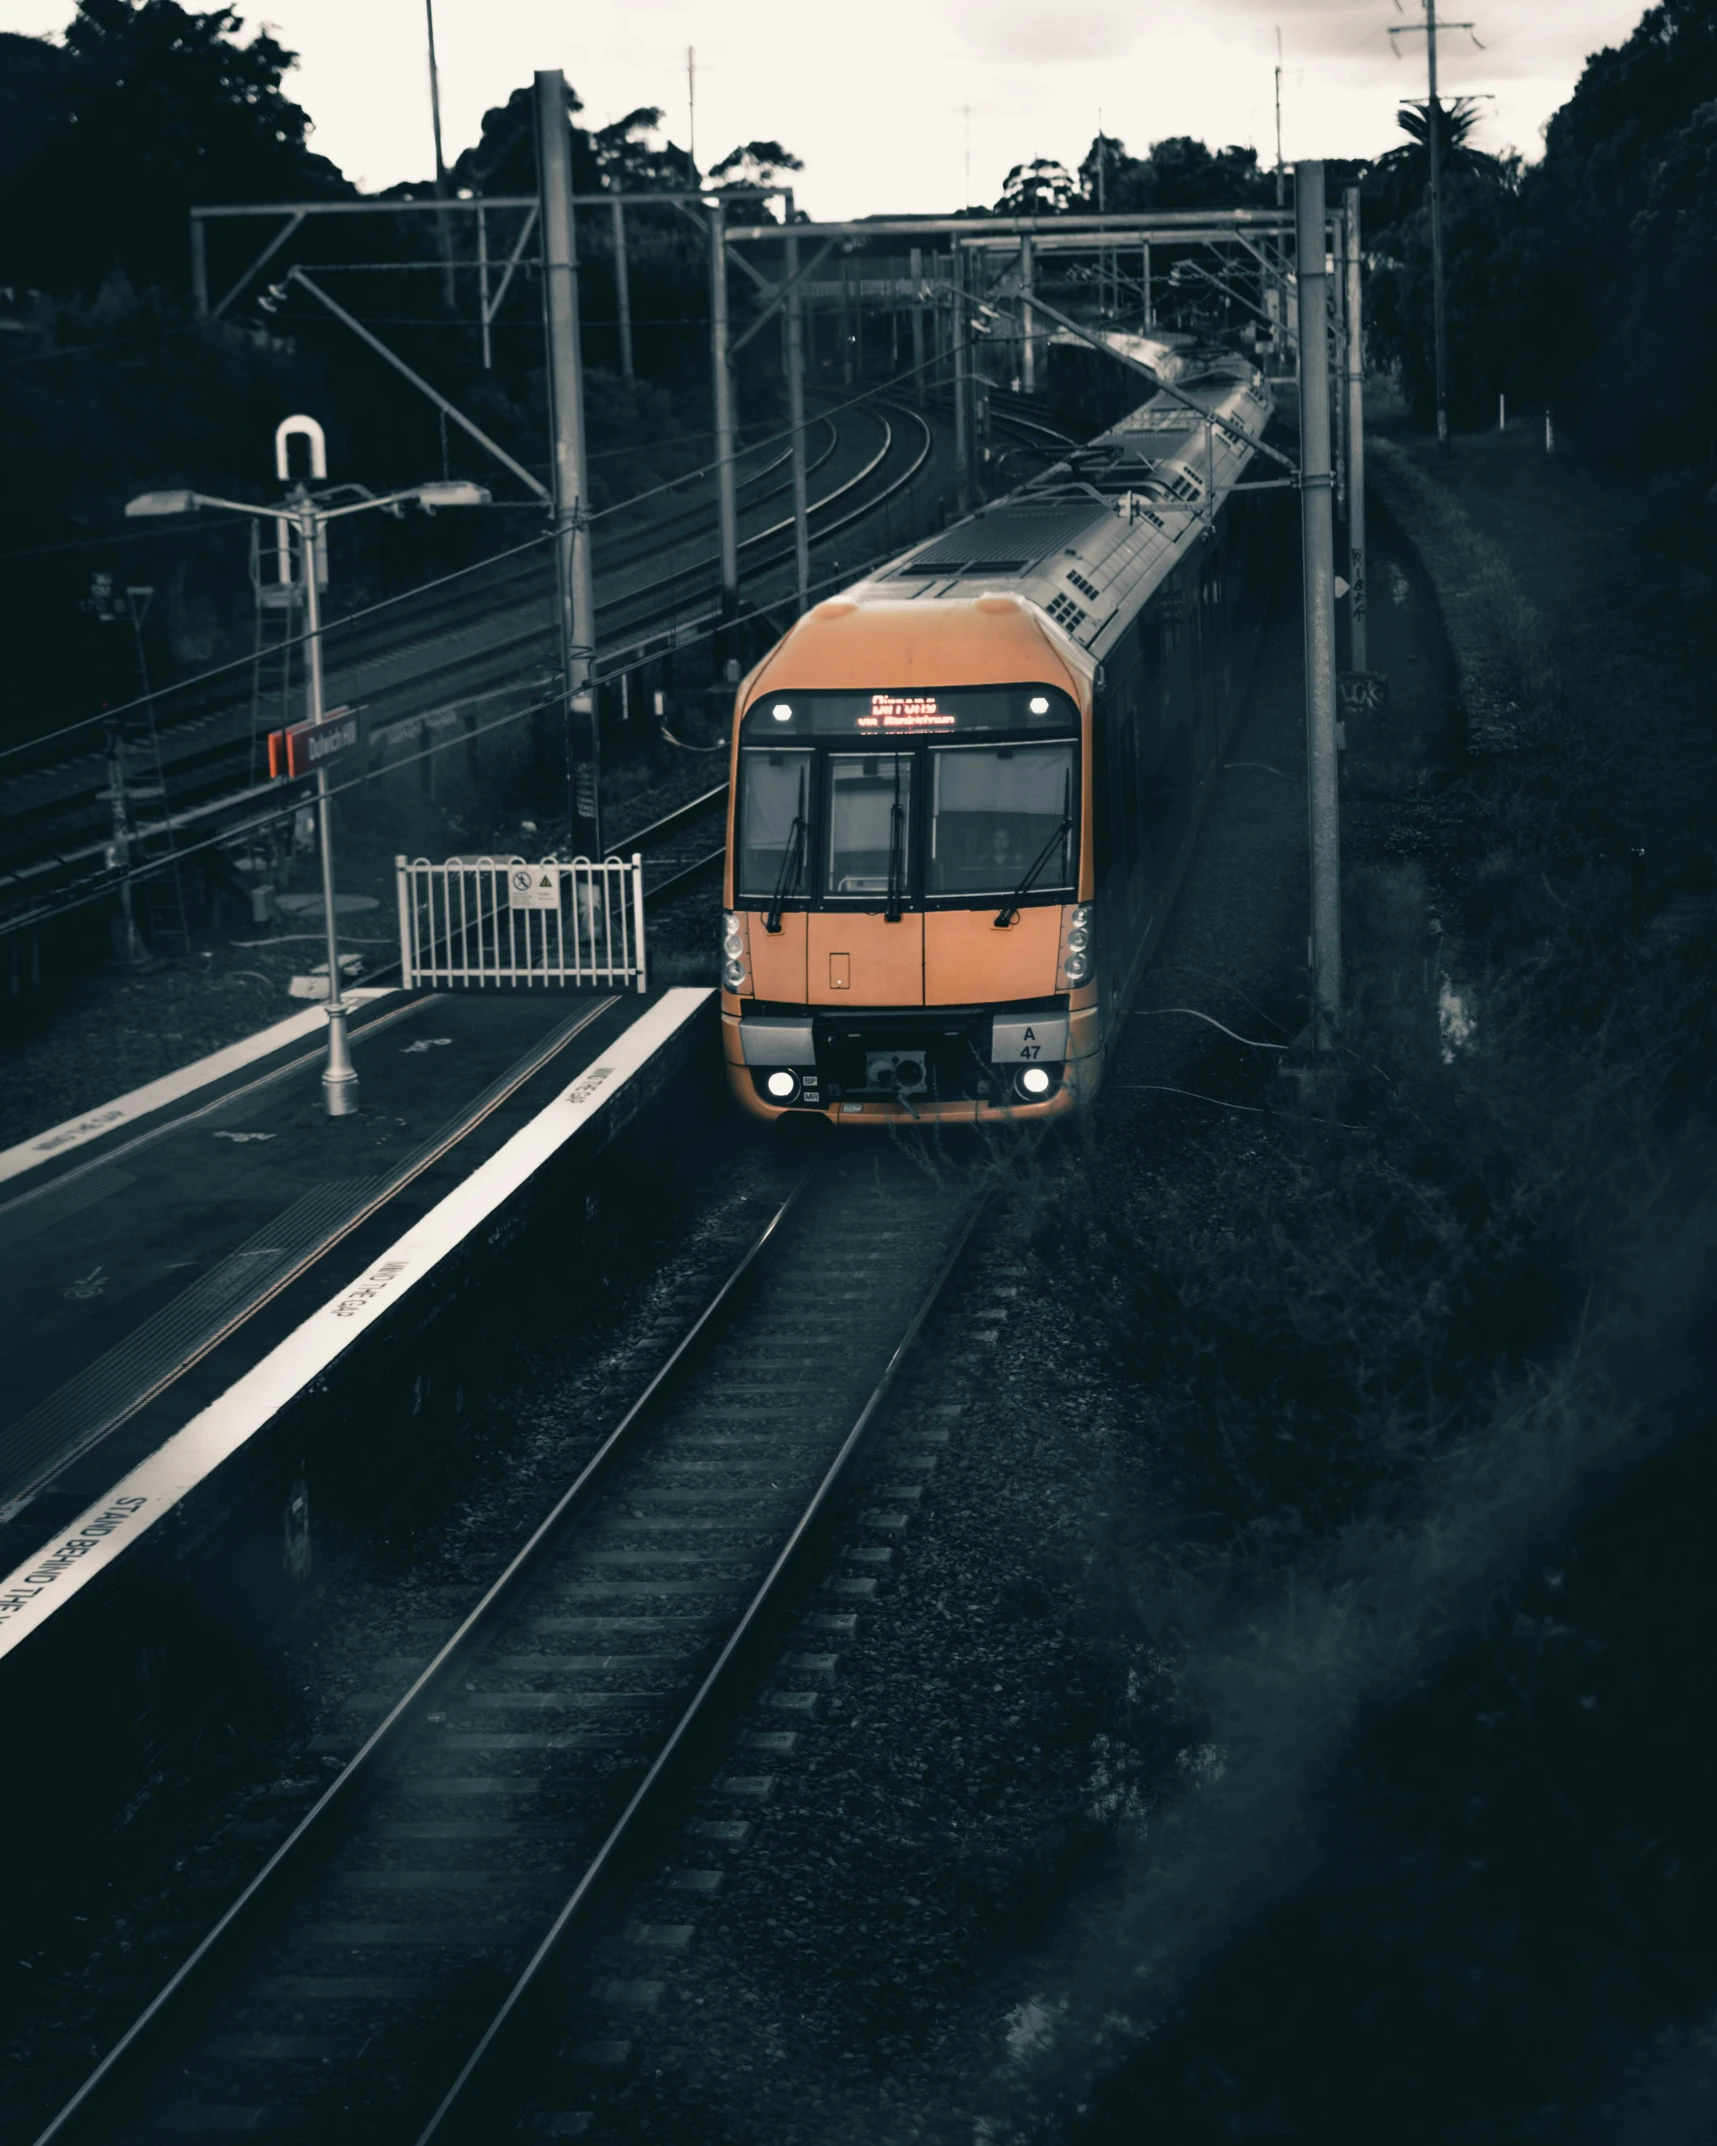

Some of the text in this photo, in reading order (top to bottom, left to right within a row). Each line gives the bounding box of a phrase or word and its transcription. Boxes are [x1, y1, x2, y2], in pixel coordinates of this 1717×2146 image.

[1023, 1027, 1036, 1041] A
[1020, 1045, 1041, 1060] 47
[804, 1077, 816, 1085] BP
[805, 1093, 818, 1101] MR
[330, 1261, 412, 1317] MIND THE GAP
[80, 1497, 148, 1537] STAND
[24, 1539, 101, 1584] BEHIND
